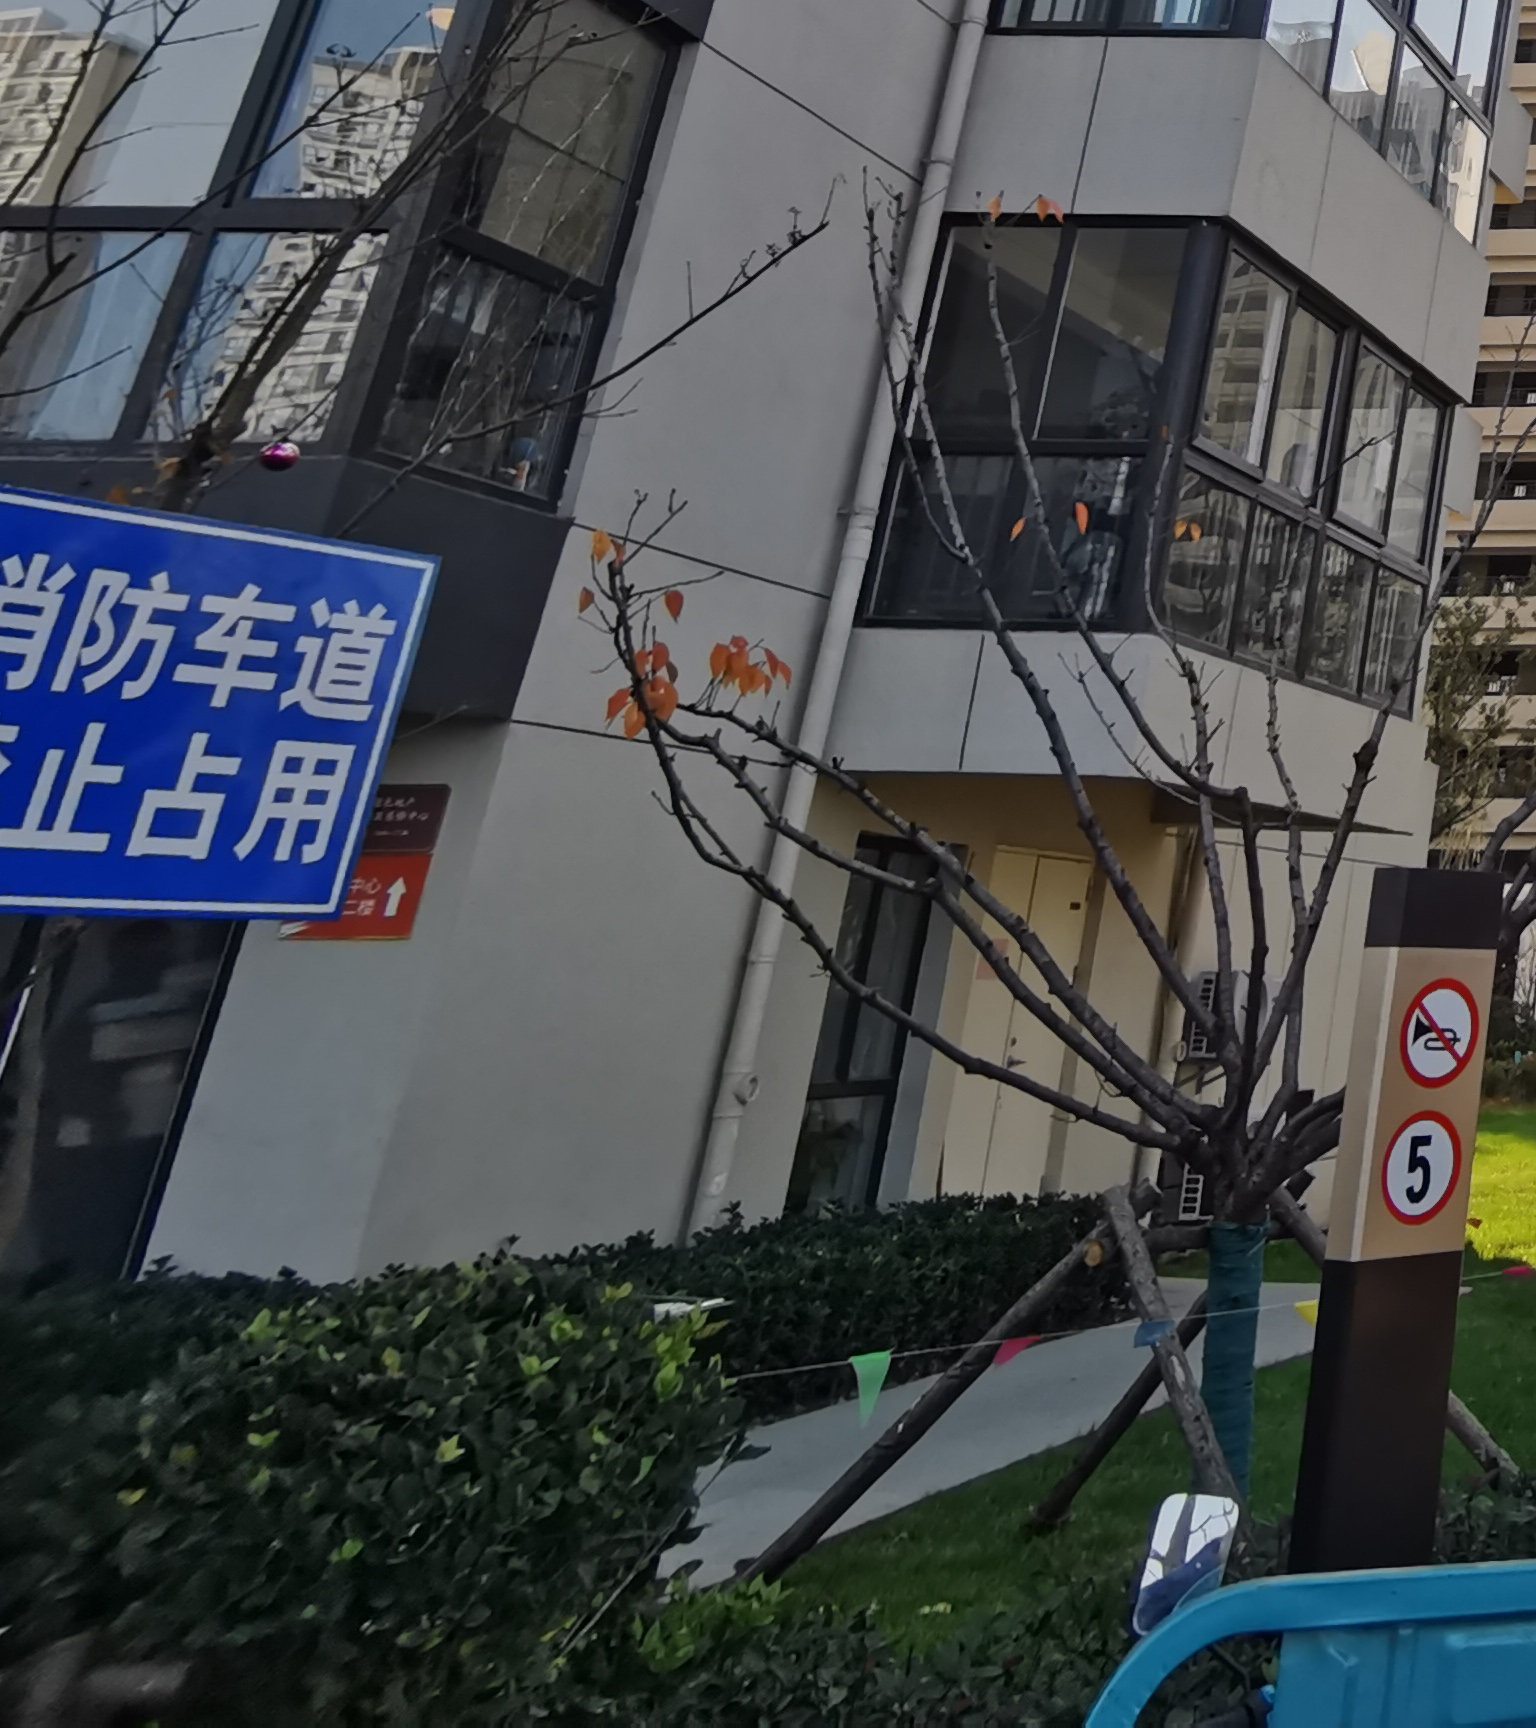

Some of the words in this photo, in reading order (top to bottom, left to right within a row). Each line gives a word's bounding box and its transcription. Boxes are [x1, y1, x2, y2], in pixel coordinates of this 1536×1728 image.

[0, 722, 357, 865] 止占用
[1405, 1134, 1433, 1205] 5
